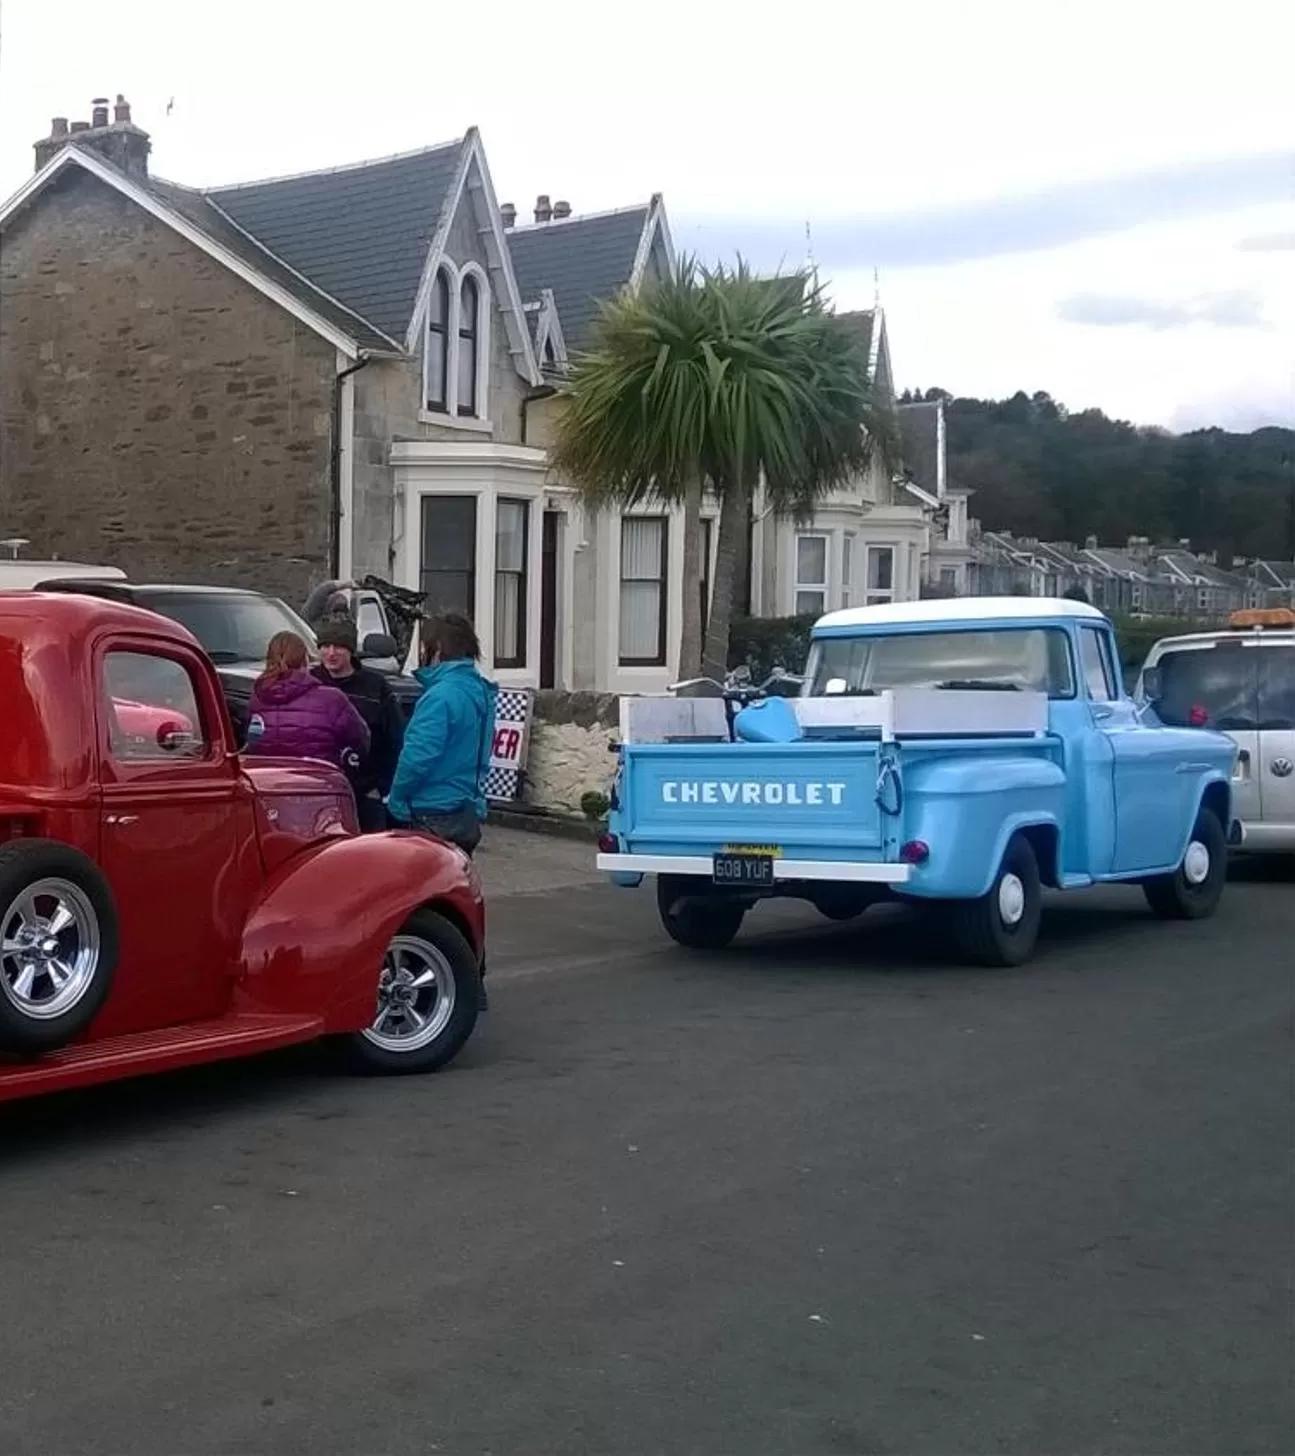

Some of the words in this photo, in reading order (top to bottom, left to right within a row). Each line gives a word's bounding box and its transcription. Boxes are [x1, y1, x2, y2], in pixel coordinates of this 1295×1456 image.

[491, 728, 520, 760] ER
[661, 781, 846, 805] CHEVROLET
[715, 859, 742, 878] 608
[745, 860, 770, 879] YUF
